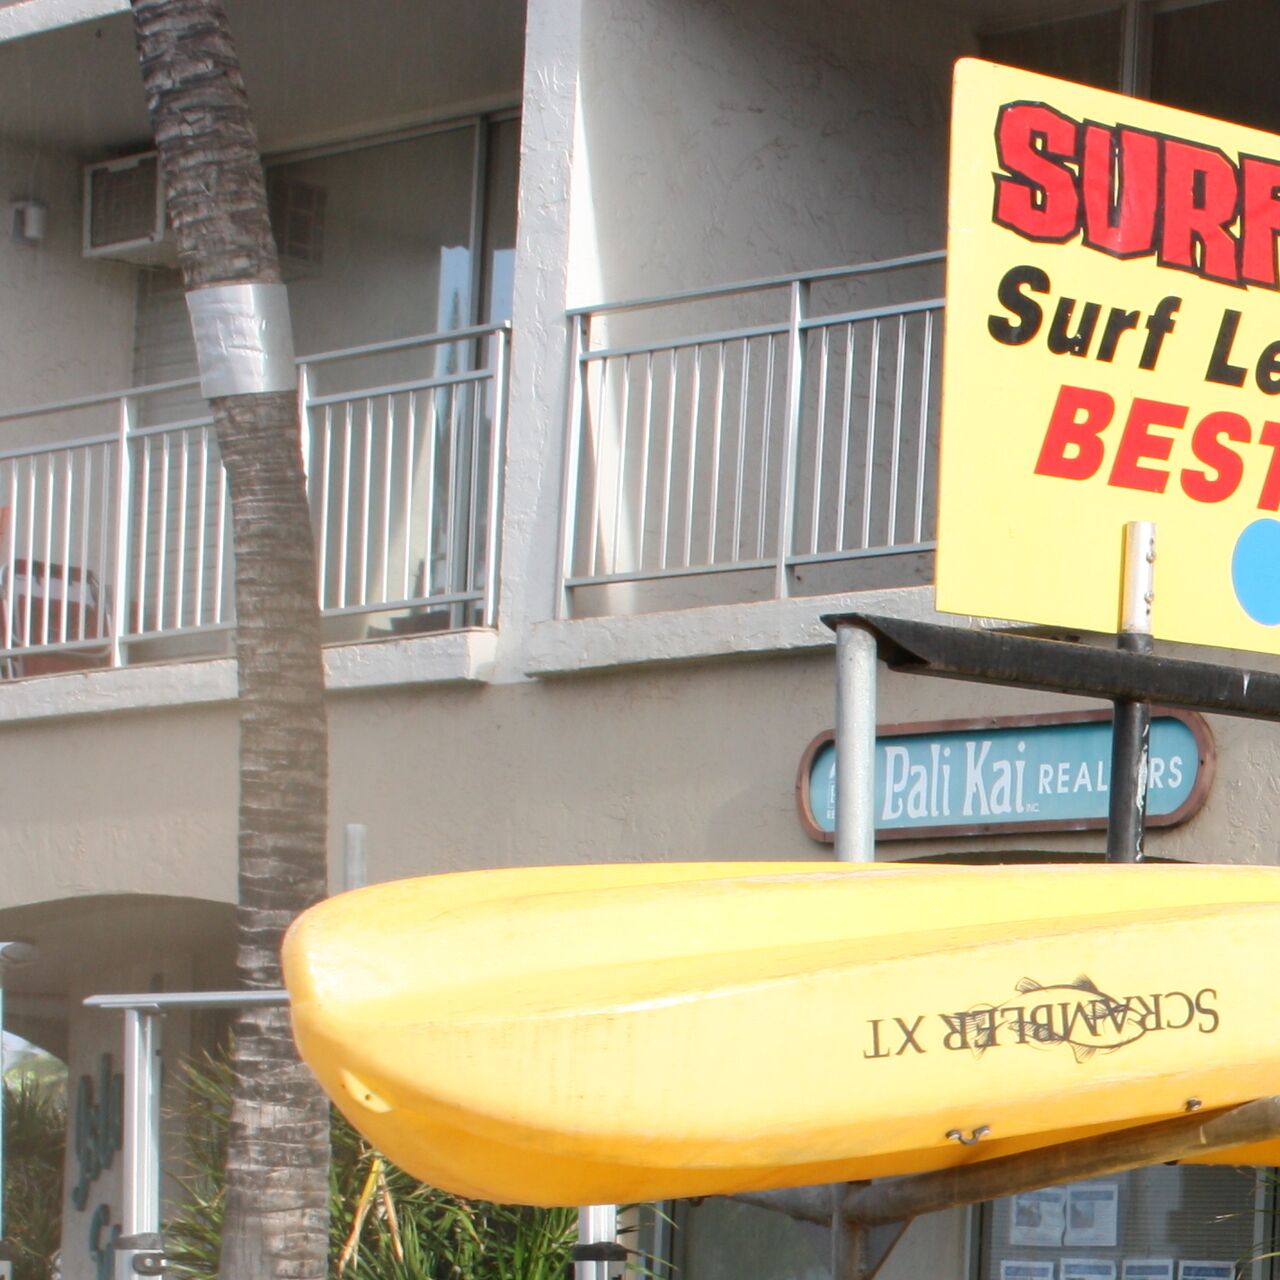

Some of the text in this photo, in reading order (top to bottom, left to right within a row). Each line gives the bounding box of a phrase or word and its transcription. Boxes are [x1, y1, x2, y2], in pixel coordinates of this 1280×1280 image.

[987, 265, 1183, 371] Surf
[882, 744, 951, 821] Pali
[963, 741, 1026, 816] Kai
[1039, 755, 1184, 795] REALRS
[863, 988, 1219, 1059] SCRAMBLER XT
